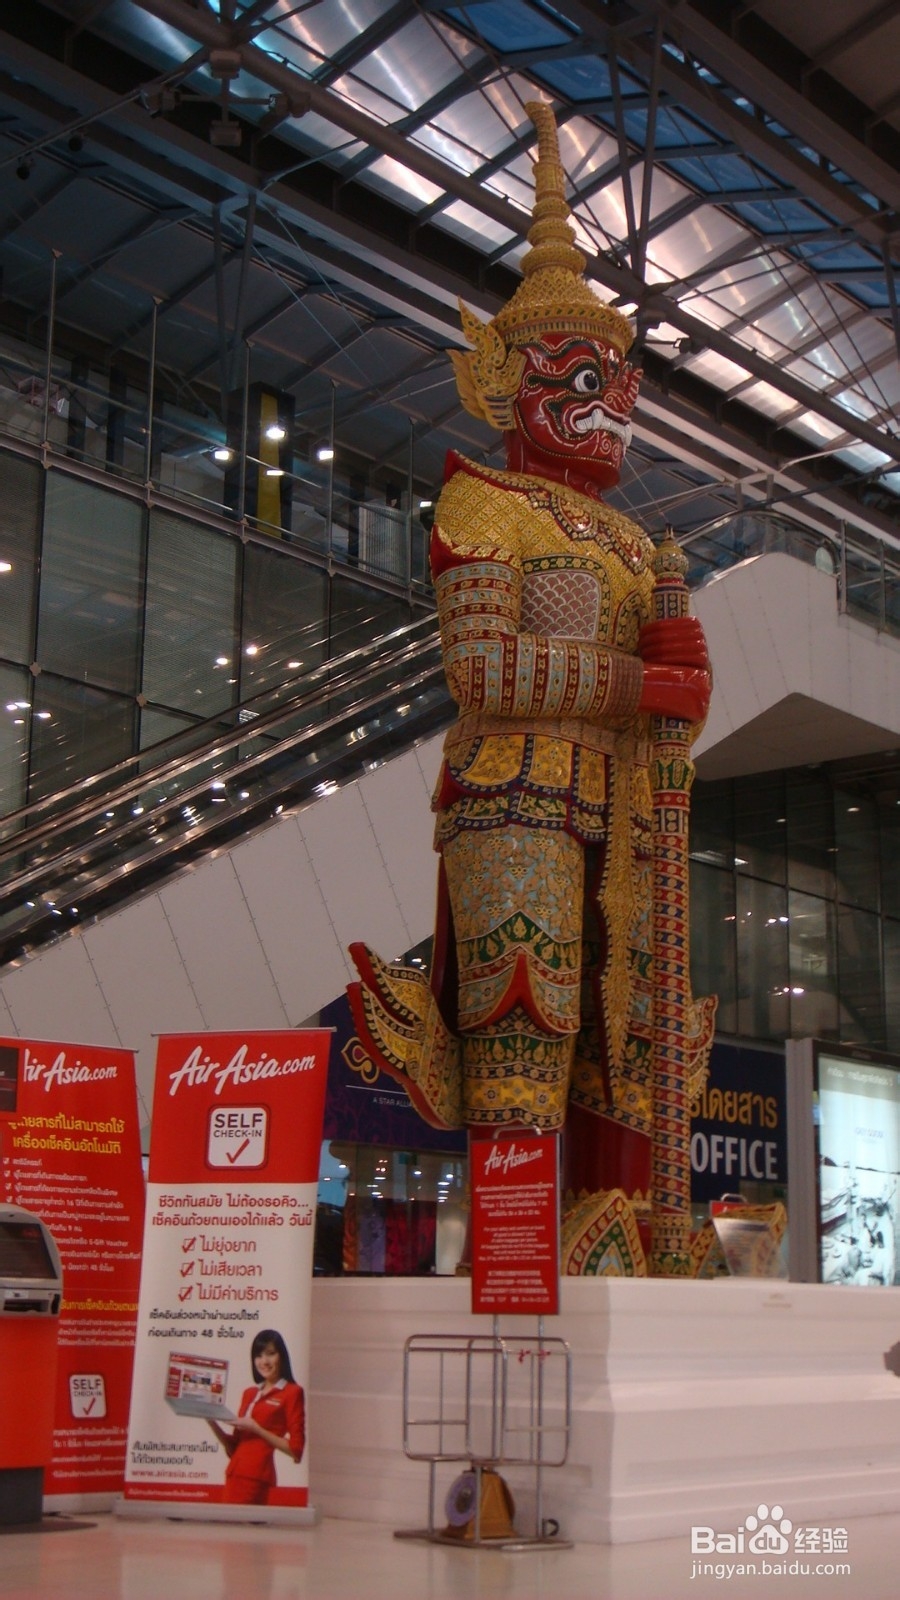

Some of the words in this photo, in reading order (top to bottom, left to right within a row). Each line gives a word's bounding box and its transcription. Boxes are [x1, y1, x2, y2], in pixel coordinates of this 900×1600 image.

[214, 1113, 263, 1128] SELF
[213, 1129, 263, 1138] CHECK-IN
[690, 1132, 778, 1180] OFFICE
[158, 1193, 223, 1208] ชีวิตทันสมัย
[289, 1209, 313, 1227] วันนี้
[199, 1235, 257, 1256] ไม่ยุ่งยาก
[198, 1258, 262, 1277] ไม่เสียเวลา
[196, 1282, 279, 1301] ไม่มีค่าบริการ
[73, 1379, 102, 1390] SELF
